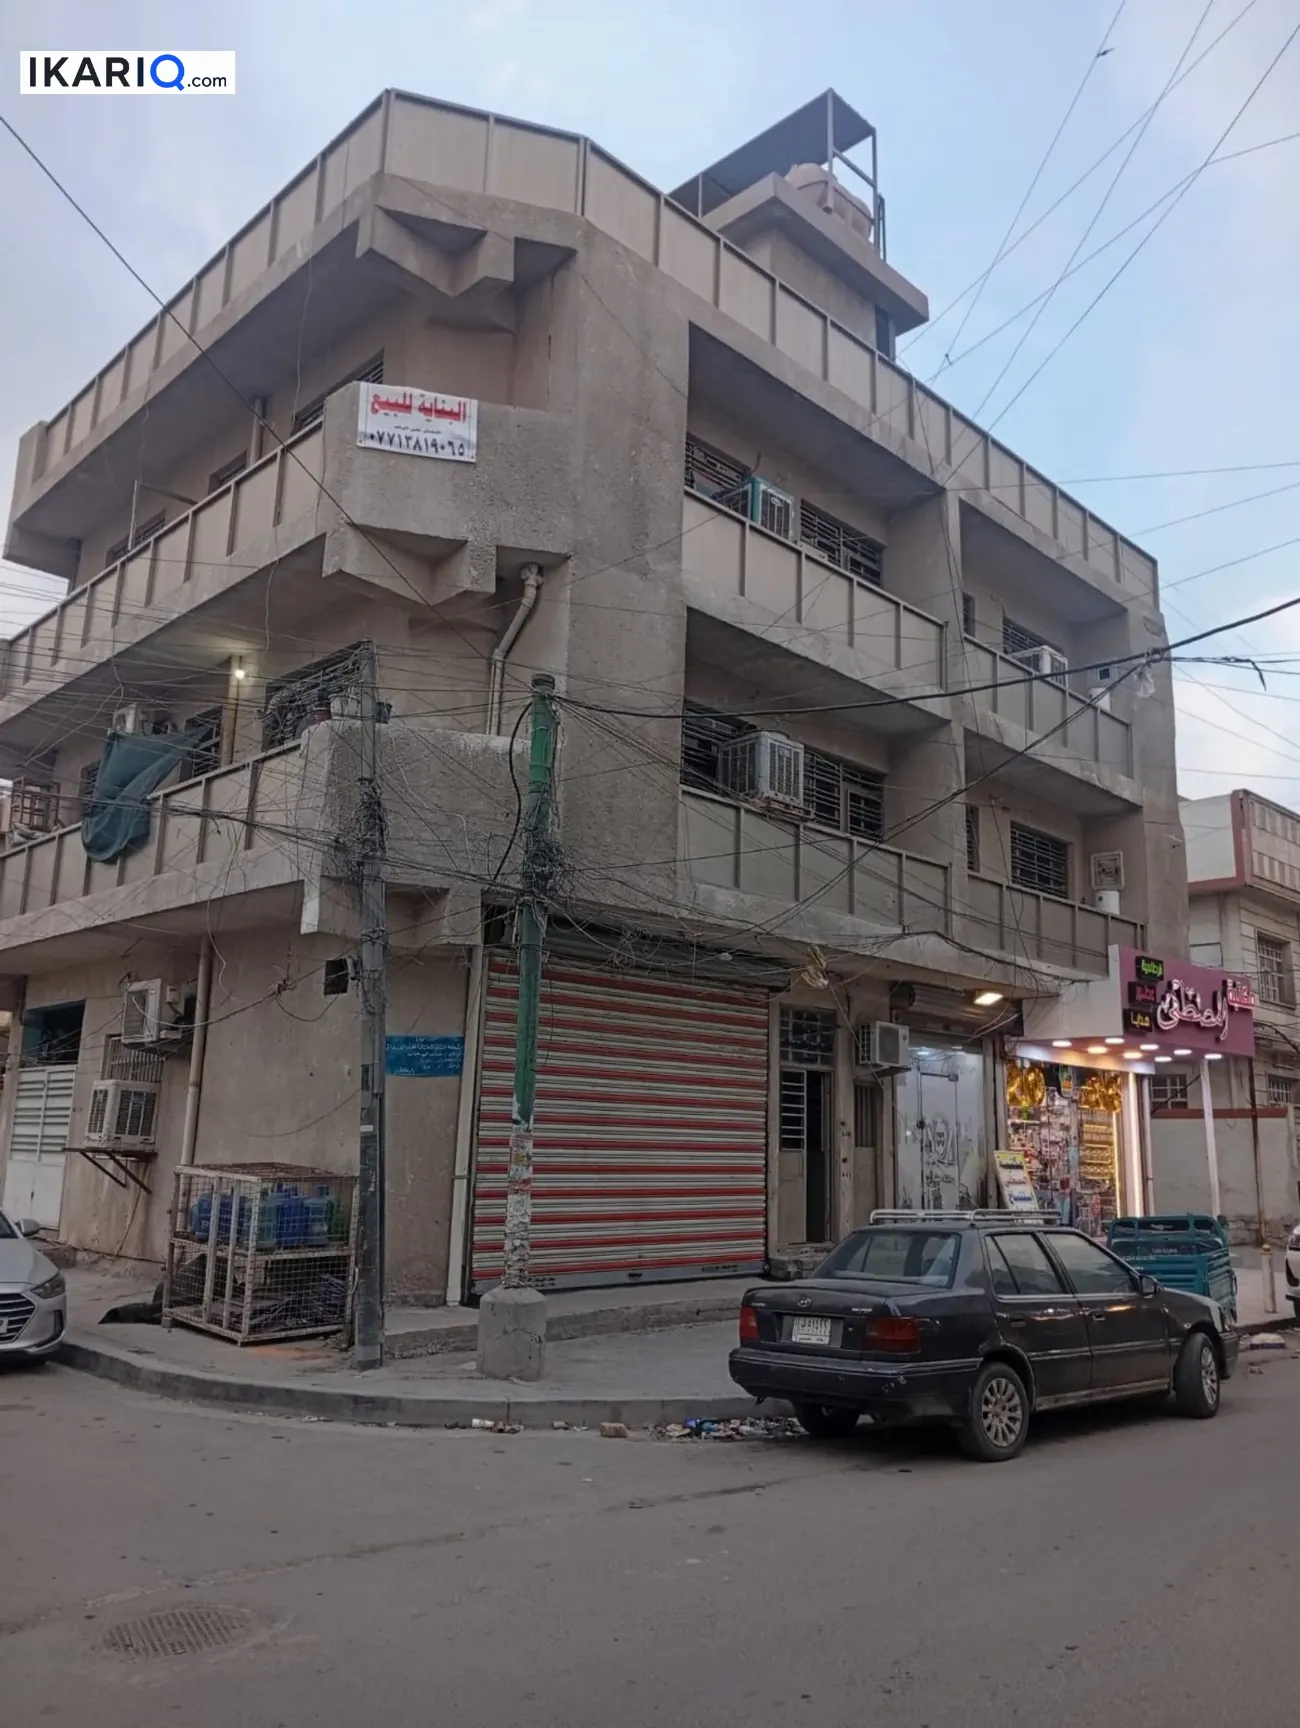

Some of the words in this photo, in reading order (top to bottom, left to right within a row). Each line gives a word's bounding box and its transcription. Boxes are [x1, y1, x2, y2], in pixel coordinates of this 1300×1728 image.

[371, 392, 413, 417] للبيع
[418, 394, 466, 425] البناية
[1227, 979, 1255, 1011] مكتبة
